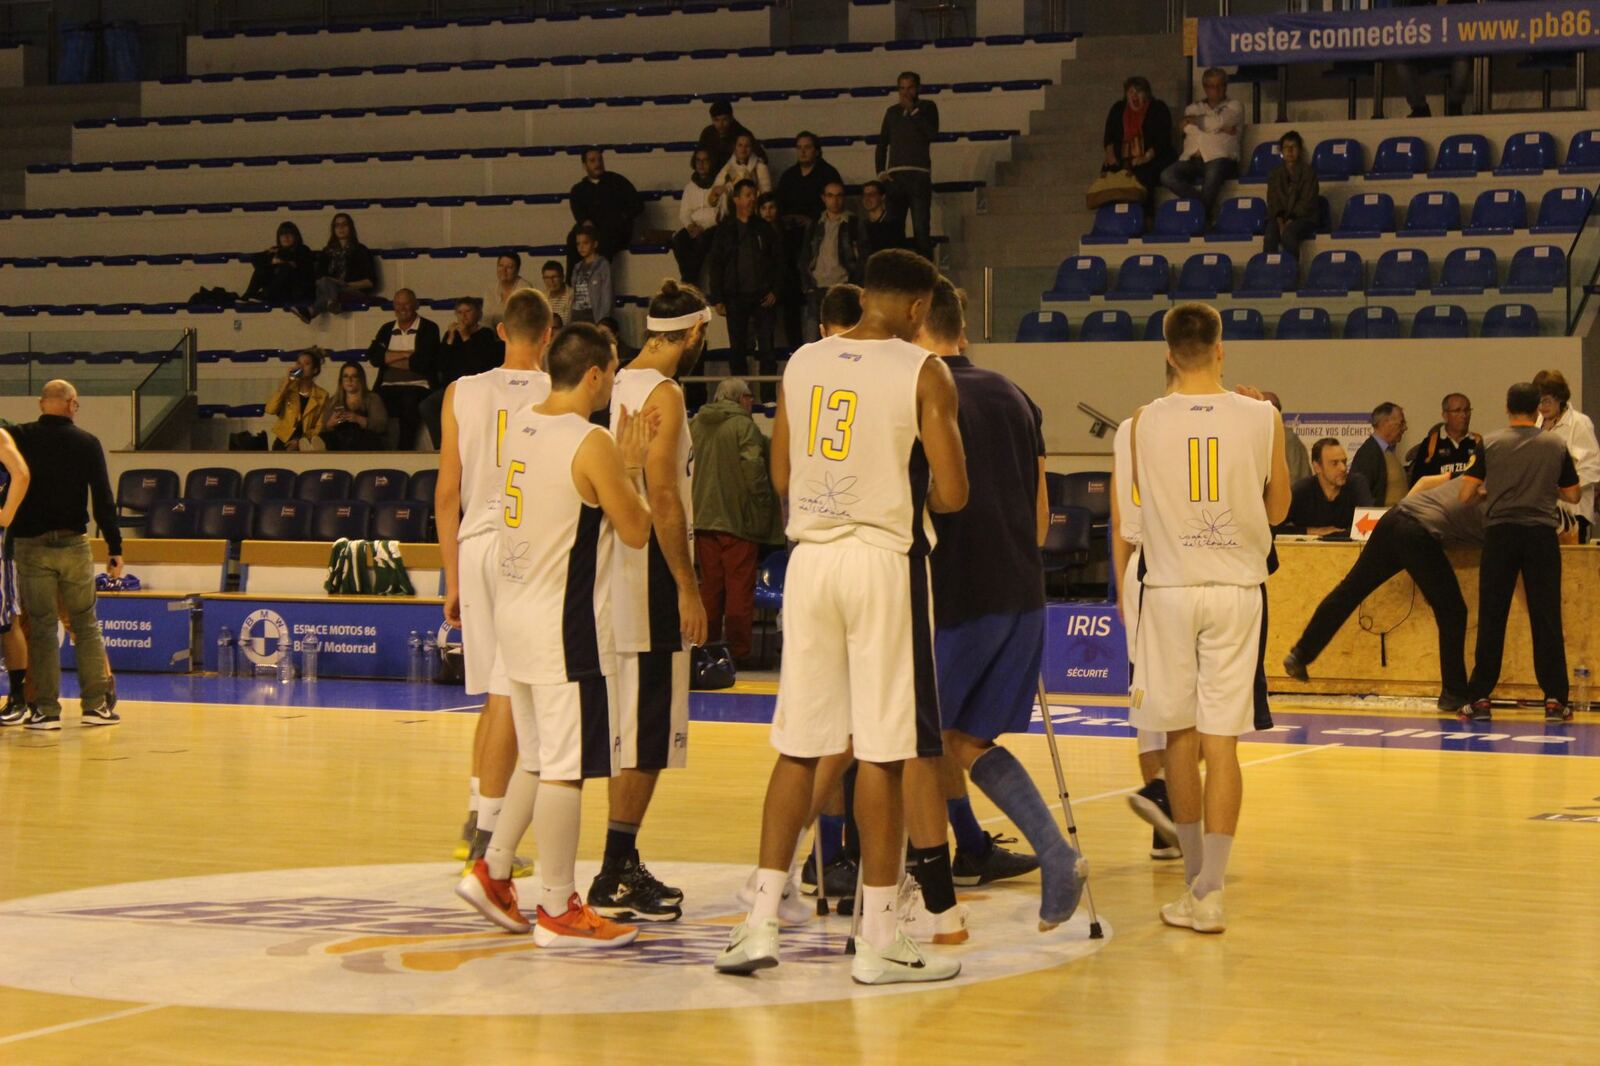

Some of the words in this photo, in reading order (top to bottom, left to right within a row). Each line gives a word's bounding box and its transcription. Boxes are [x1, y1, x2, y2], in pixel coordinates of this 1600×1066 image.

[1230, 27, 1302, 52] restez
[1309, 18, 1431, 49] connectés
[1441, 17, 1448, 43] !
[808, 385, 858, 461] 13
[1326, 427, 1339, 436] VOS
[1188, 437, 1219, 502] 11
[1440, 463, 1454, 475] NEW
[504, 460, 526, 528] 5
[105, 620, 138, 630] MOTOS
[140, 620, 151, 631] 86
[330, 625, 363, 636] MOTOS
[364, 626, 376, 636] 86
[1067, 615, 1112, 637] IRIS
[325, 641, 376, 654] Motorrad
[1066, 667, 1109, 678] SÉCURITÉ
